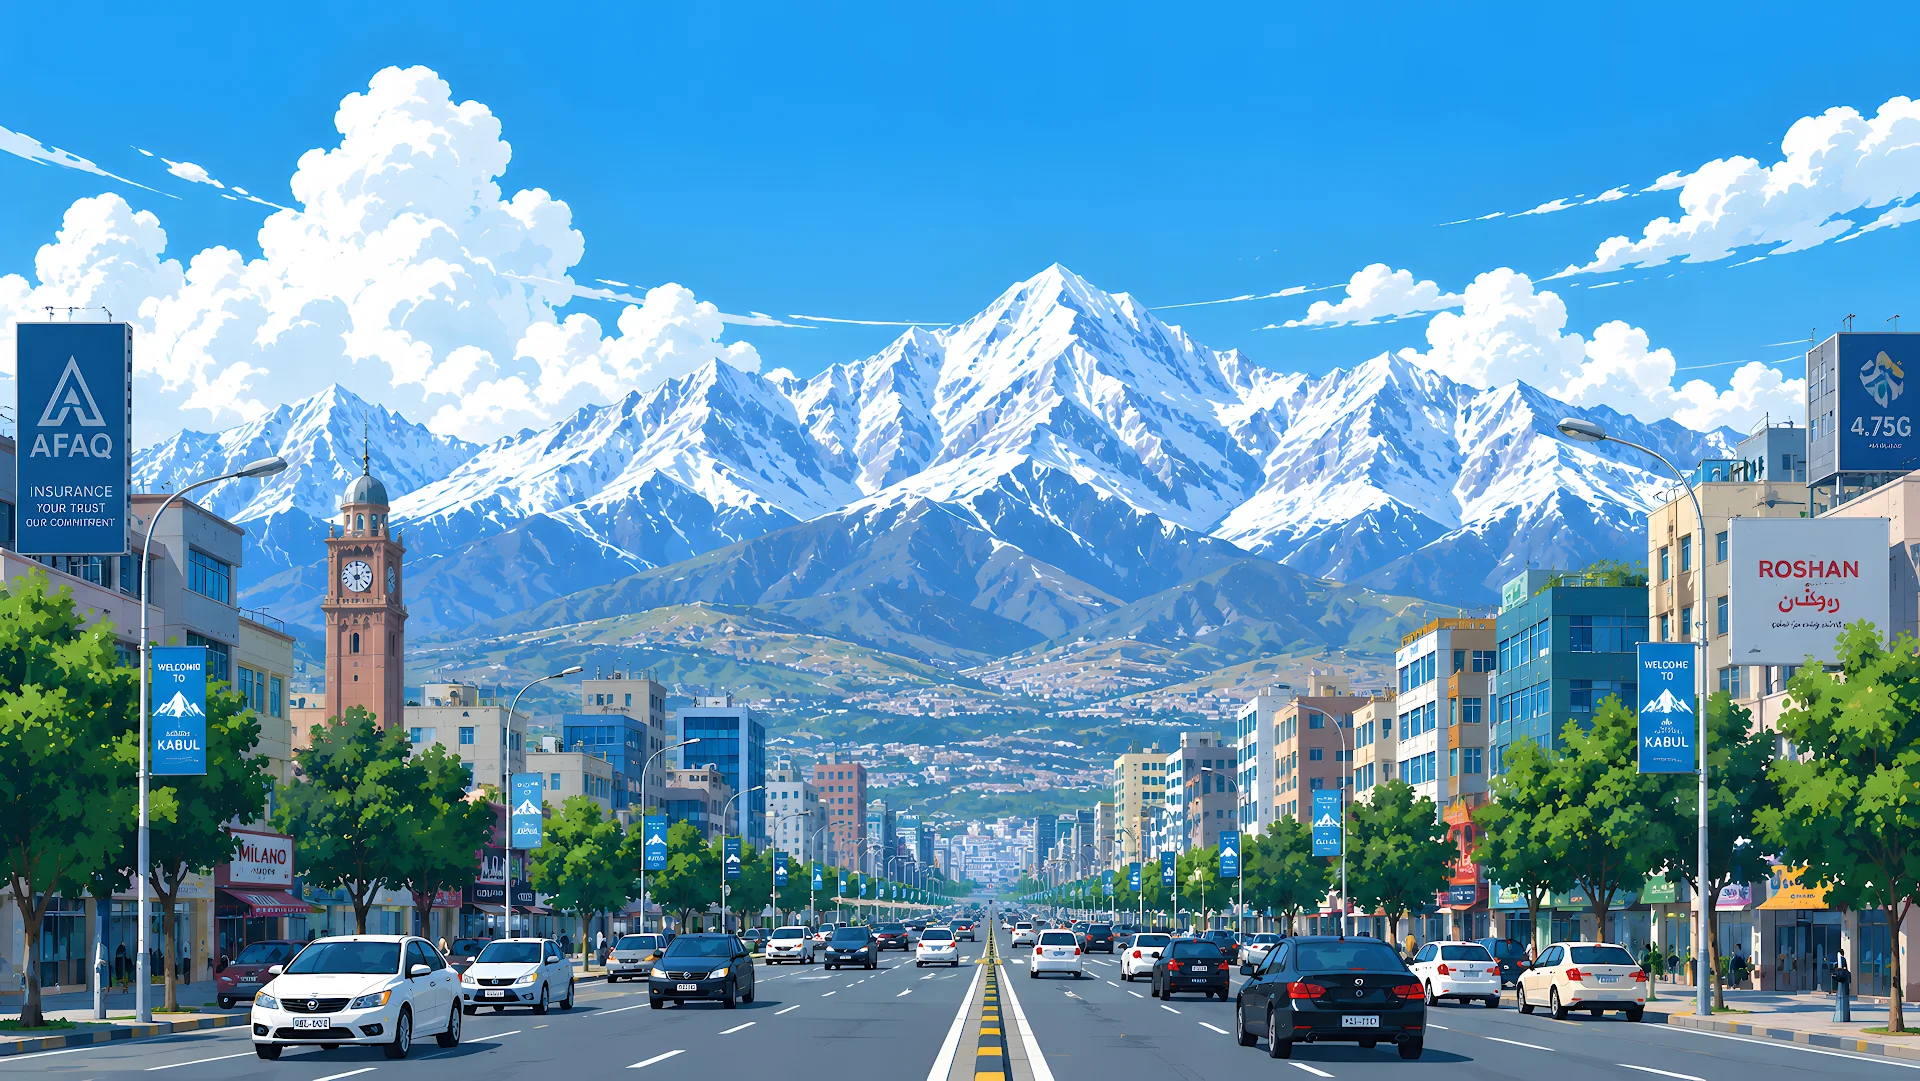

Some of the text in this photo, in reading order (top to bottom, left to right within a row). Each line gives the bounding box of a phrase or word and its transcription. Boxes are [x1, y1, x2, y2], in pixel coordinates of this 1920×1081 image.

[1850, 416, 1912, 437] 4.75G
[30, 433, 113, 459] AFAQ
[37, 502, 106, 513] YOUR TRUST
[25, 518, 47, 528] OUR
[1759, 560, 1859, 578] ROSHAN
[172, 673, 186, 683] TO
[1660, 671, 1674, 681] TO
[157, 739, 201, 751] KABUL
[1644, 736, 1689, 748] KABUL
